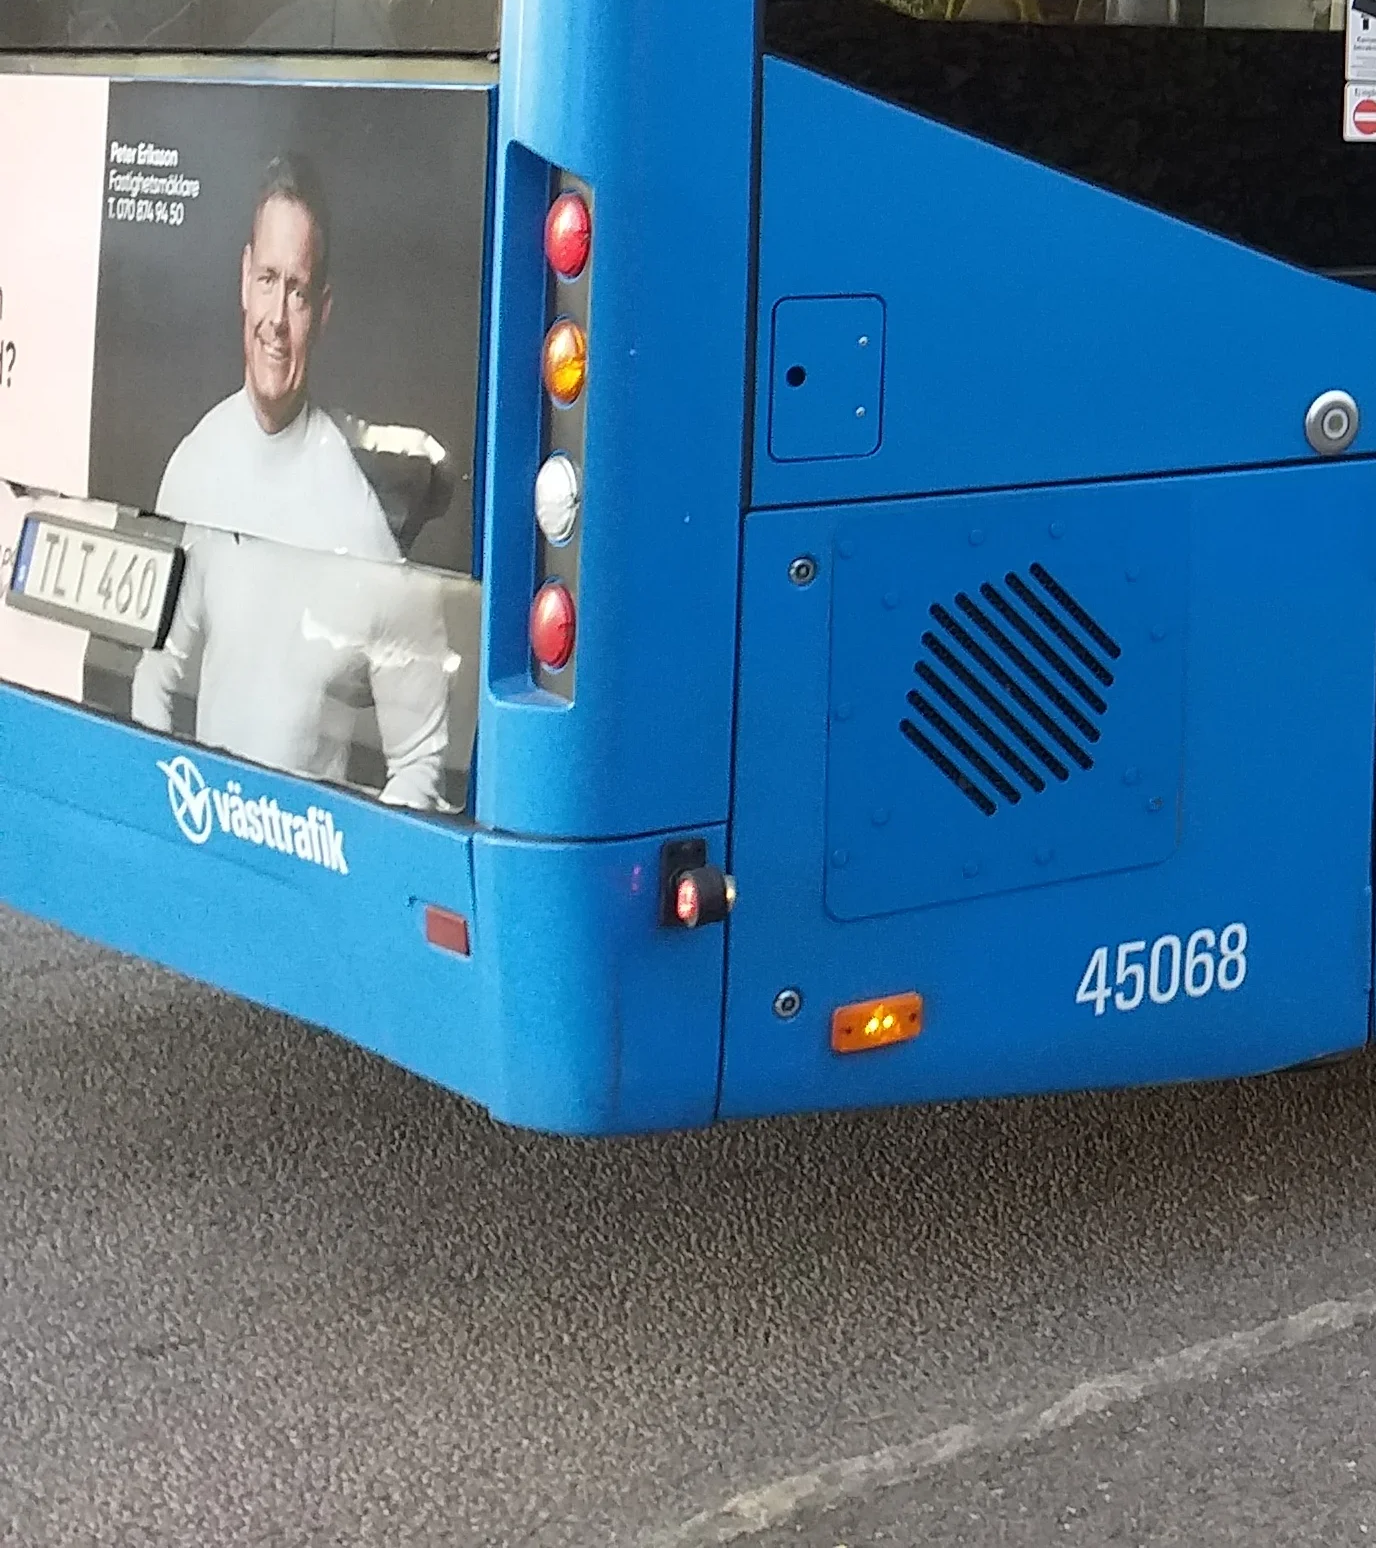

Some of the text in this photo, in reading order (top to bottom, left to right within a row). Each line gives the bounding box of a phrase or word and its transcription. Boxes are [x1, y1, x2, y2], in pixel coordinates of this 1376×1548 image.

[110, 141, 179, 167] Peter Eriksson
[155, 200, 168, 223] 94
[168, 202, 184, 226] 50
[41, 532, 157, 620] TLT 460
[212, 780, 349, 875] västtrafik
[1075, 922, 1248, 1016] 45068
